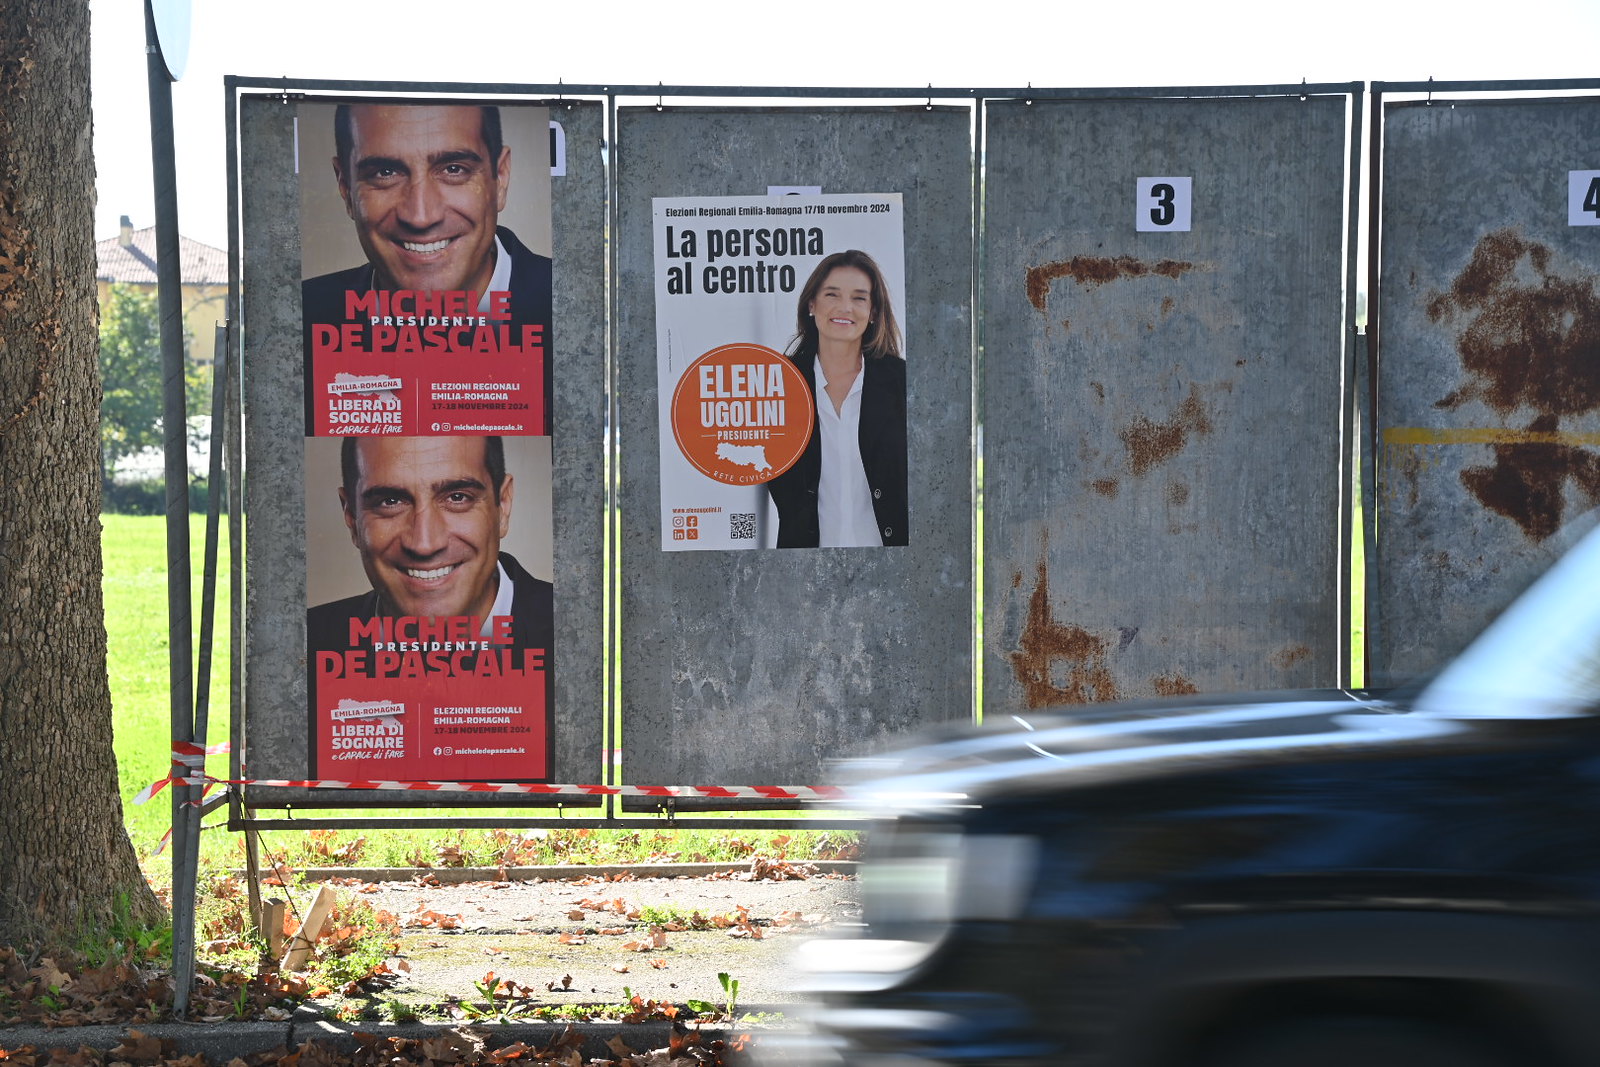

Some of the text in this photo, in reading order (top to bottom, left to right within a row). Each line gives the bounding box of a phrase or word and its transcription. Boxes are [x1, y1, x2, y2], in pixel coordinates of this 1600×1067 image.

[1583, 177, 1600, 218] 4
[665, 203, 890, 217] Elezioni Regionali Emilia-Romagna 17/18 novembre 2024
[1150, 183, 1175, 226] 3
[666, 226, 824, 262] La persona
[667, 261, 796, 295] al centro
[345, 290, 512, 320] MICHELE
[371, 316, 486, 326] PRESIDENTE
[312, 323, 544, 352] DE PASCALE
[331, 381, 399, 392] EMILIA-ROMAGNA
[431, 383, 520, 391] ELEZIONI REGIONALI
[699, 364, 785, 399] ELENA
[431, 393, 509, 401] EMILIA-ROMAGNA
[329, 399, 402, 411] LIBERA DI
[329, 411, 402, 424] SOGNARE
[700, 400, 786, 428] UGOLINI
[336, 425, 370, 434] CAPACE
[382, 425, 403, 434] FARE
[453, 423, 524, 432] micheledepascale.it
[717, 430, 770, 440] PRESIDENTE
[713, 470, 772, 483] RETE CIVICA
[349, 615, 514, 646] MICHELE
[375, 641, 489, 652] PRESIDENTE
[316, 648, 545, 678] DE PASCALE
[334, 706, 401, 717] EMILIA-ROMAGNA
[433, 707, 474, 715] ELEZIONI
[433, 716, 511, 724] EMILIA-ROMAGNA
[332, 724, 404, 737] LIBERA DI
[332, 737, 404, 749] SOGNARE
[339, 751, 372, 760] CAPACE
[373, 749, 383, 759] di
[384, 750, 404, 759] FARE
[455, 747, 525, 755] micheledepascale.it
